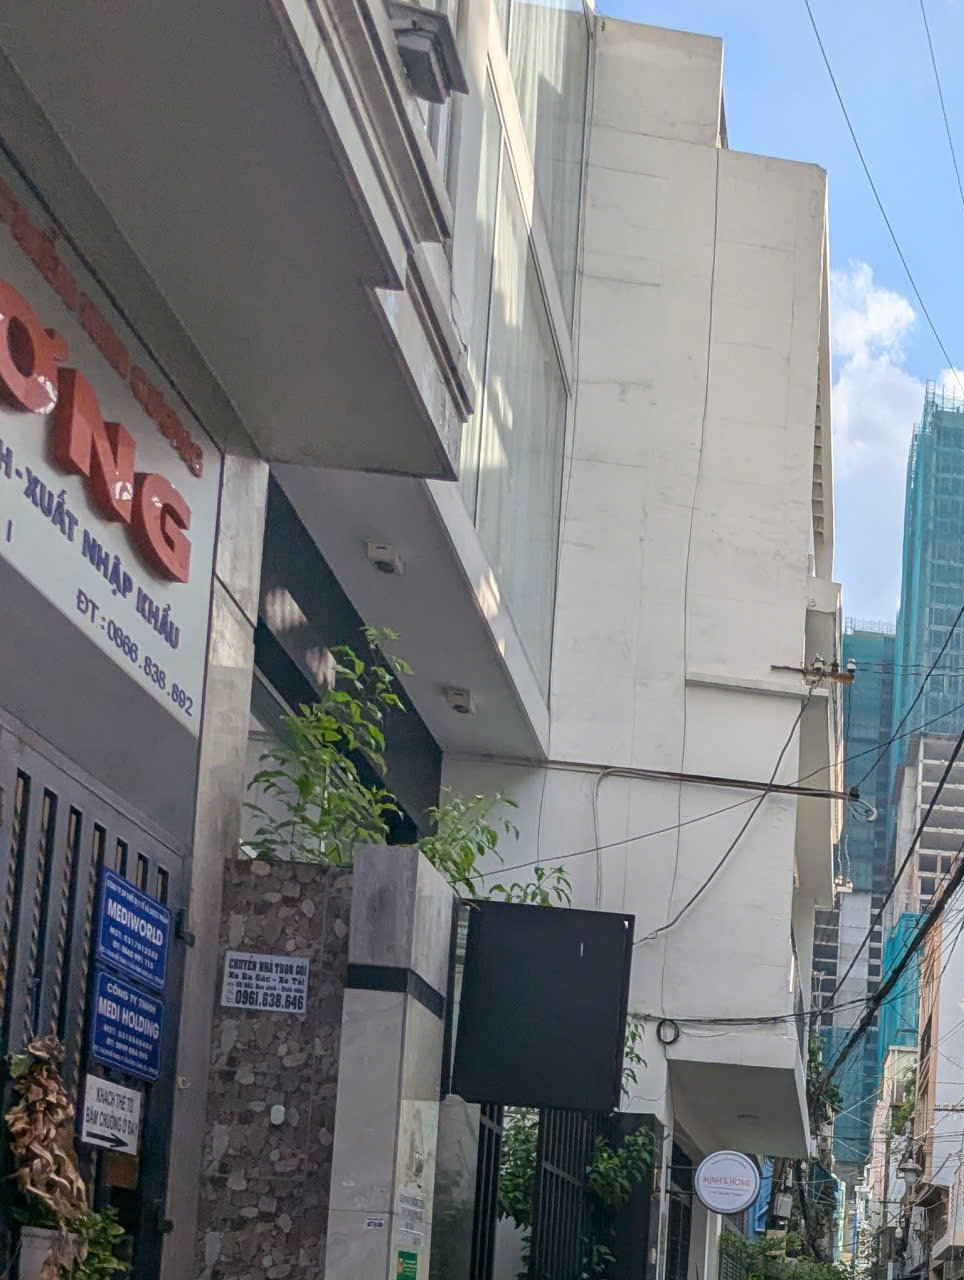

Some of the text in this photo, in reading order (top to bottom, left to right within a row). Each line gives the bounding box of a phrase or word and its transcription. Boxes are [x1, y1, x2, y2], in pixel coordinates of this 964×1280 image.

[82, 528, 133, 598] NHẬP
[136, 586, 180, 650] KHẨU
[107, 898, 163, 946] MEDIWORLD
[228, 971, 239, 979] Xe
[242, 972, 253, 981] Ba
[279, 976, 289, 984] Xe
[107, 983, 128, 1000] CÔNG
[130, 994, 138, 1005] TY
[235, 989, 304, 1010] 0961.638.646
[98, 996, 160, 1039] MEDI HOLDING
